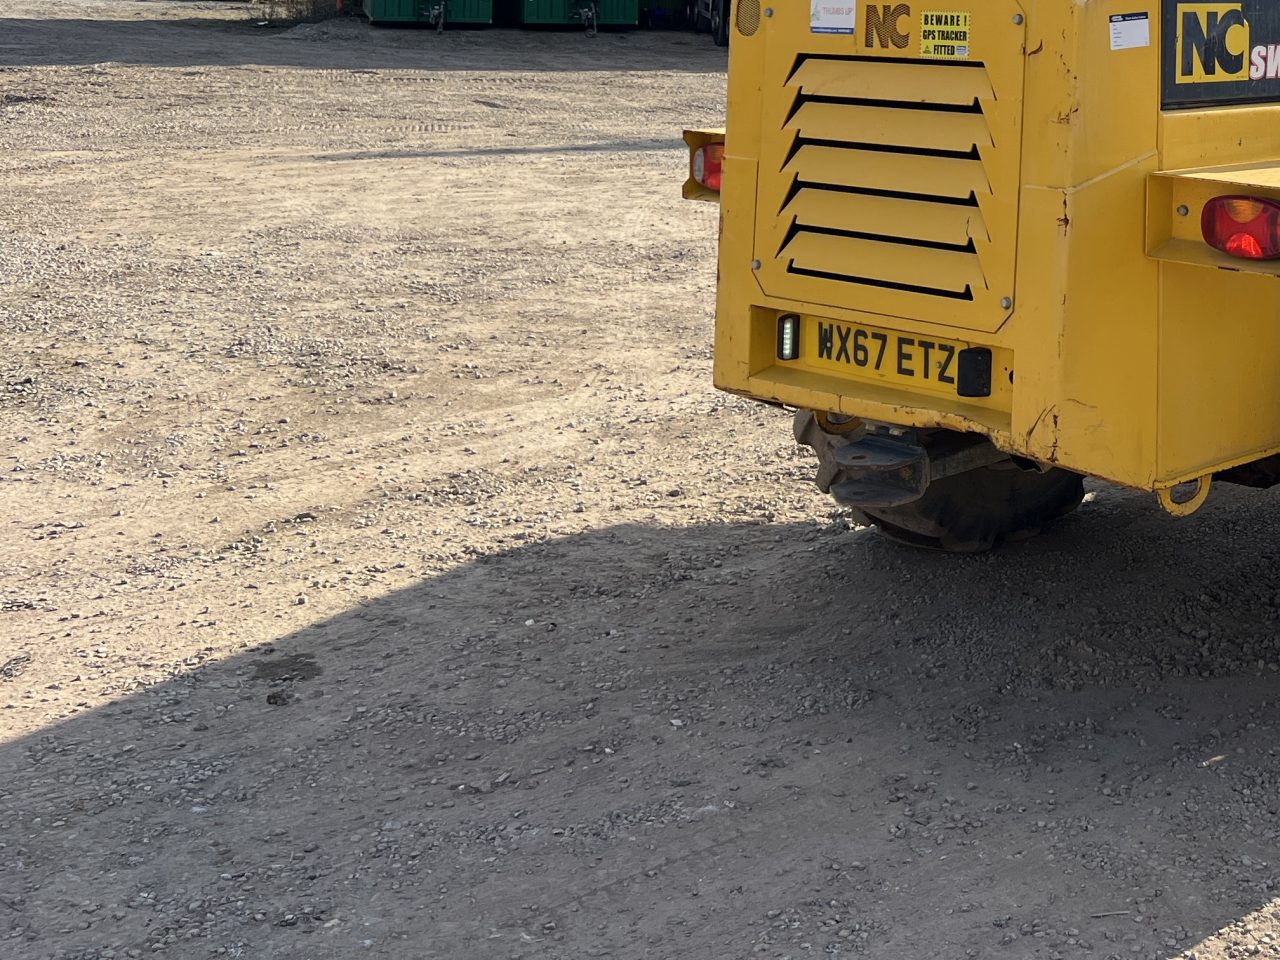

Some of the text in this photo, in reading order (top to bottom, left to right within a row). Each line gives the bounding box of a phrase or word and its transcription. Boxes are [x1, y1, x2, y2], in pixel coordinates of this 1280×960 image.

[865, 3, 910, 49] NC
[924, 14, 960, 26] BEWARE
[922, 29, 967, 41] GPS TRACKER
[1181, 9, 1245, 77] NC
[933, 44, 955, 56] FITTED
[818, 321, 956, 384] WX67 ETZ
